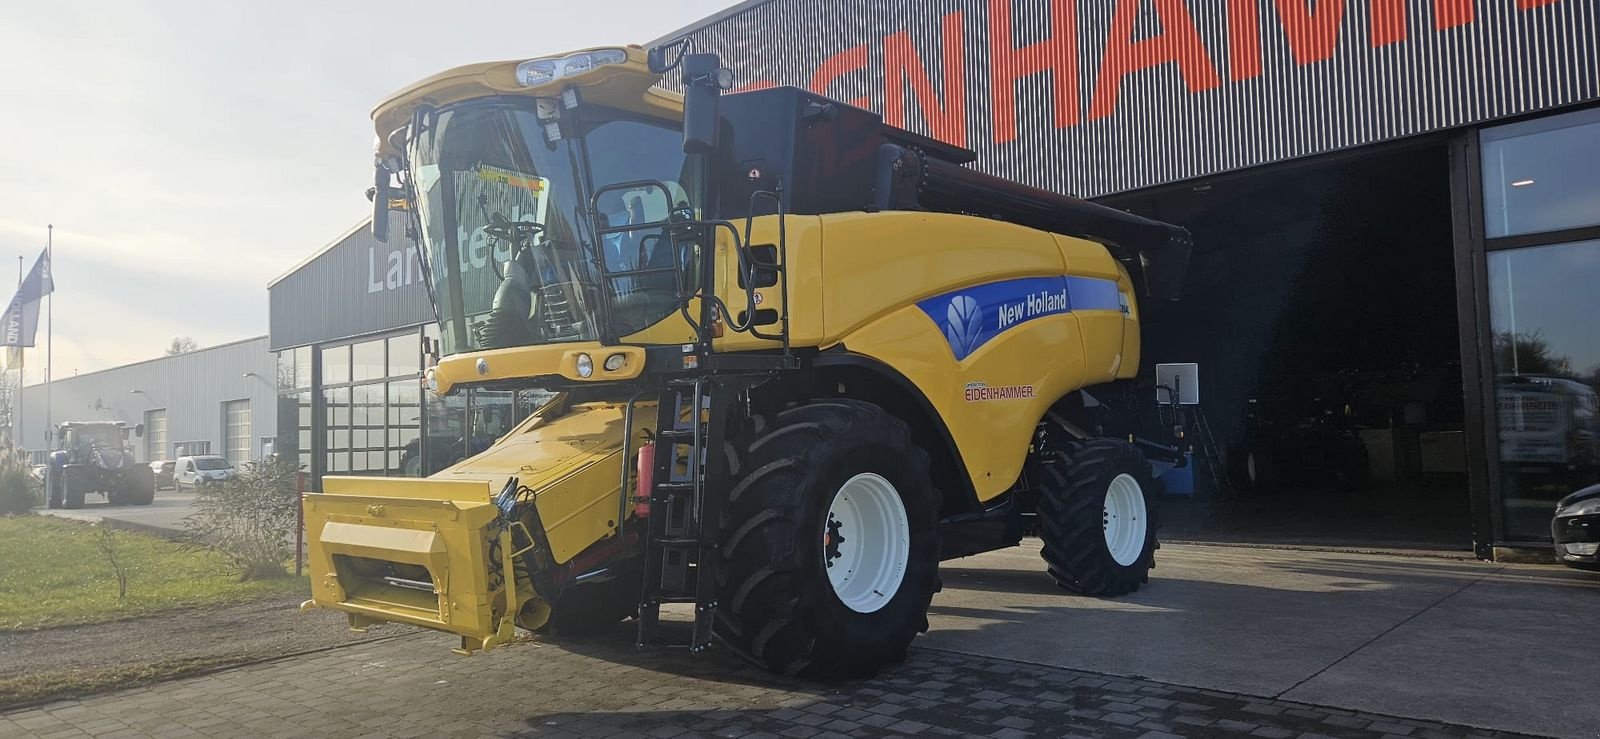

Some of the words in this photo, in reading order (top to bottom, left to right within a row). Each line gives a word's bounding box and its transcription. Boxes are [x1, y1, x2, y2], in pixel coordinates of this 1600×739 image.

[998, 303, 1025, 330] New
[1026, 288, 1067, 317] Holland
[965, 385, 1033, 401] EIDENHAMMER
